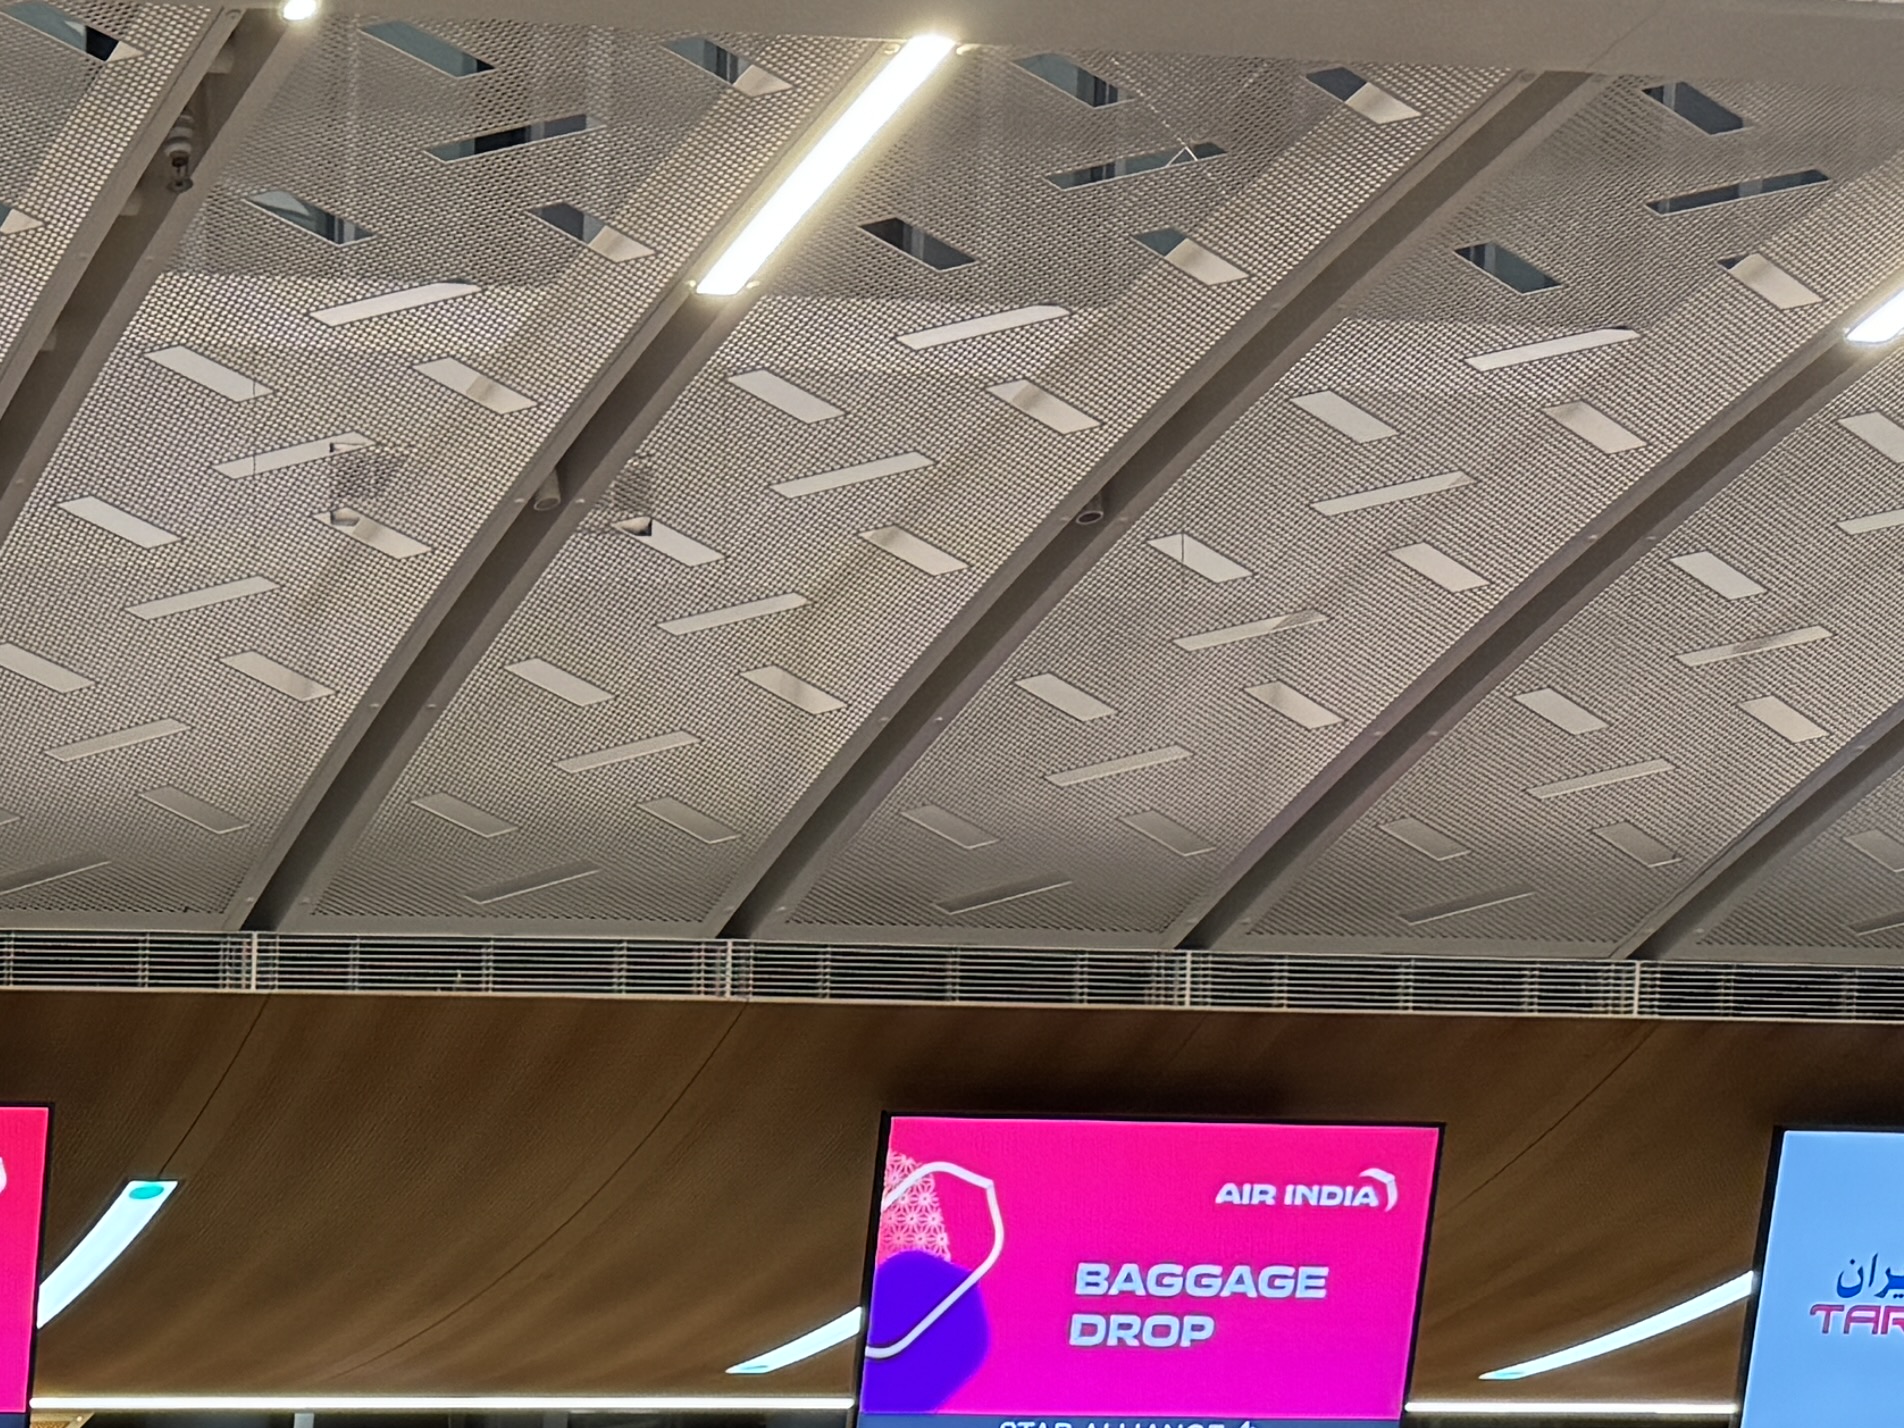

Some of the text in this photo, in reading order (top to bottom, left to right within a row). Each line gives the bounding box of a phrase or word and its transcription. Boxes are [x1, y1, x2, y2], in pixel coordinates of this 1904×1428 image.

[1215, 1182, 1380, 1208] AIR INDIA
[1075, 1262, 1330, 1299] BAGGAGE
[1068, 1314, 1215, 1348] DROP
